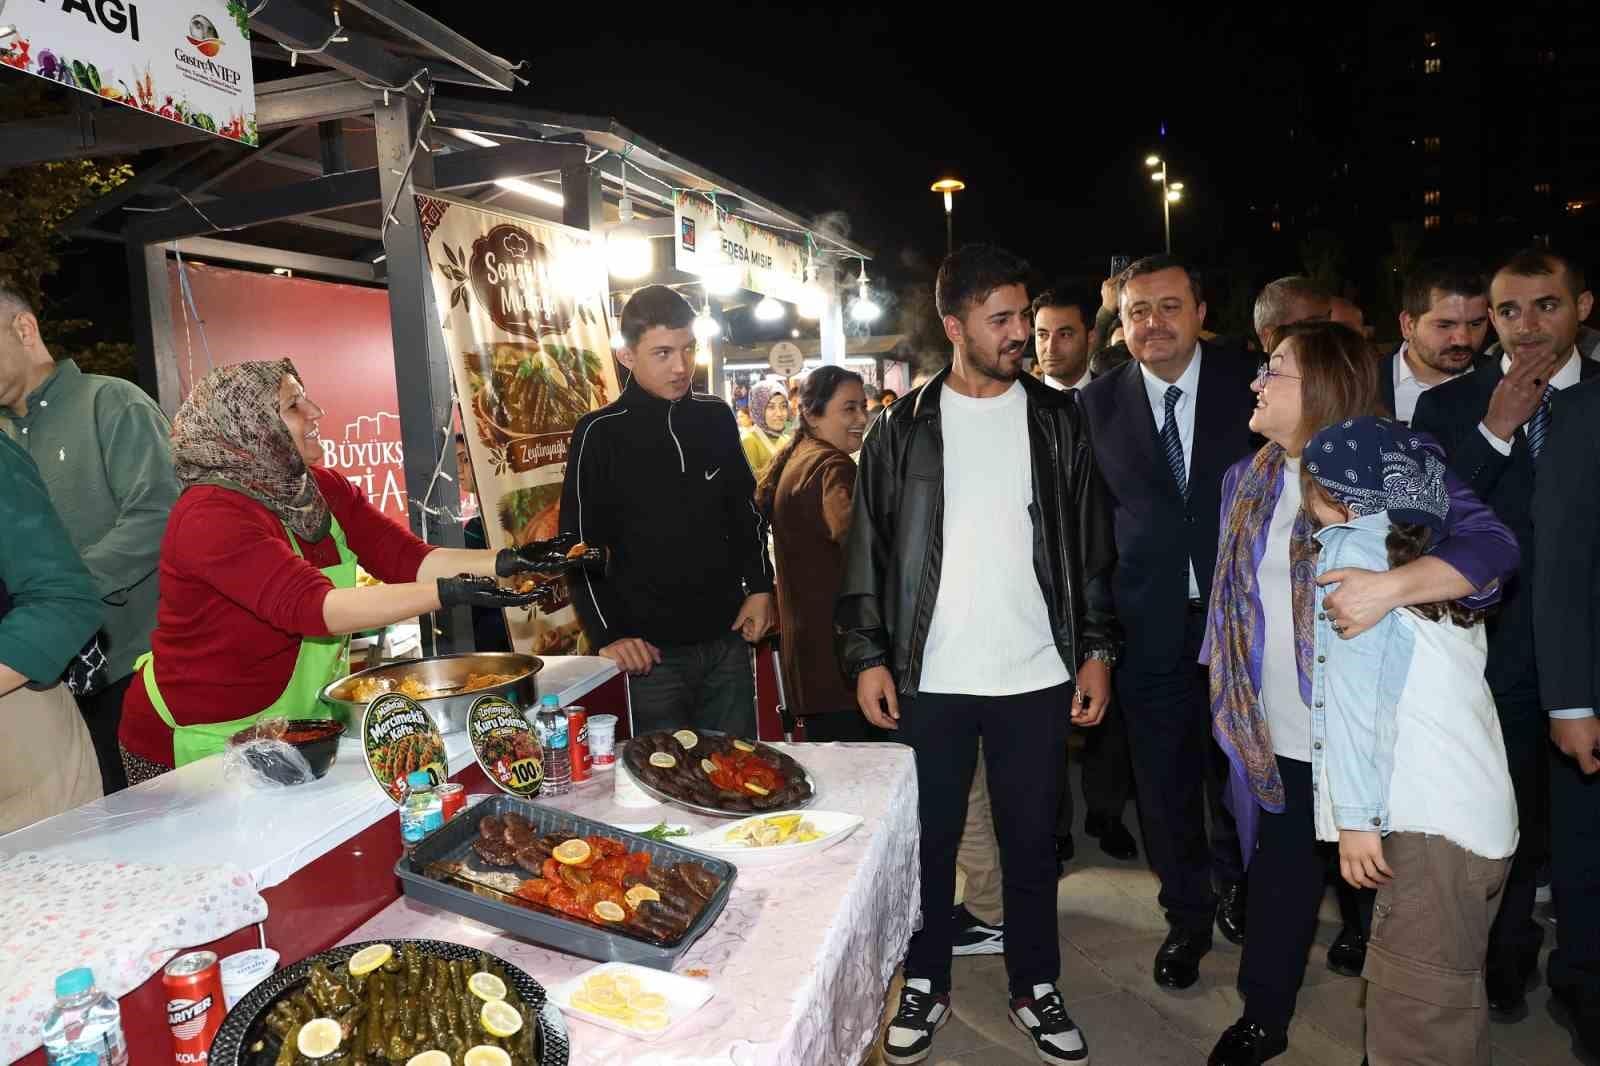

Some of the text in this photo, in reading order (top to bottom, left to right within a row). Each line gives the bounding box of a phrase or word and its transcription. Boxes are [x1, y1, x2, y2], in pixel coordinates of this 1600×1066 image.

[323, 438, 404, 470] BÜYÜKŞ
[370, 710, 426, 744] Mercimekli
[389, 724, 415, 741] Köfte
[474, 719, 498, 736] Kuru
[497, 716, 529, 730] Dolma
[512, 761, 538, 784] 100
